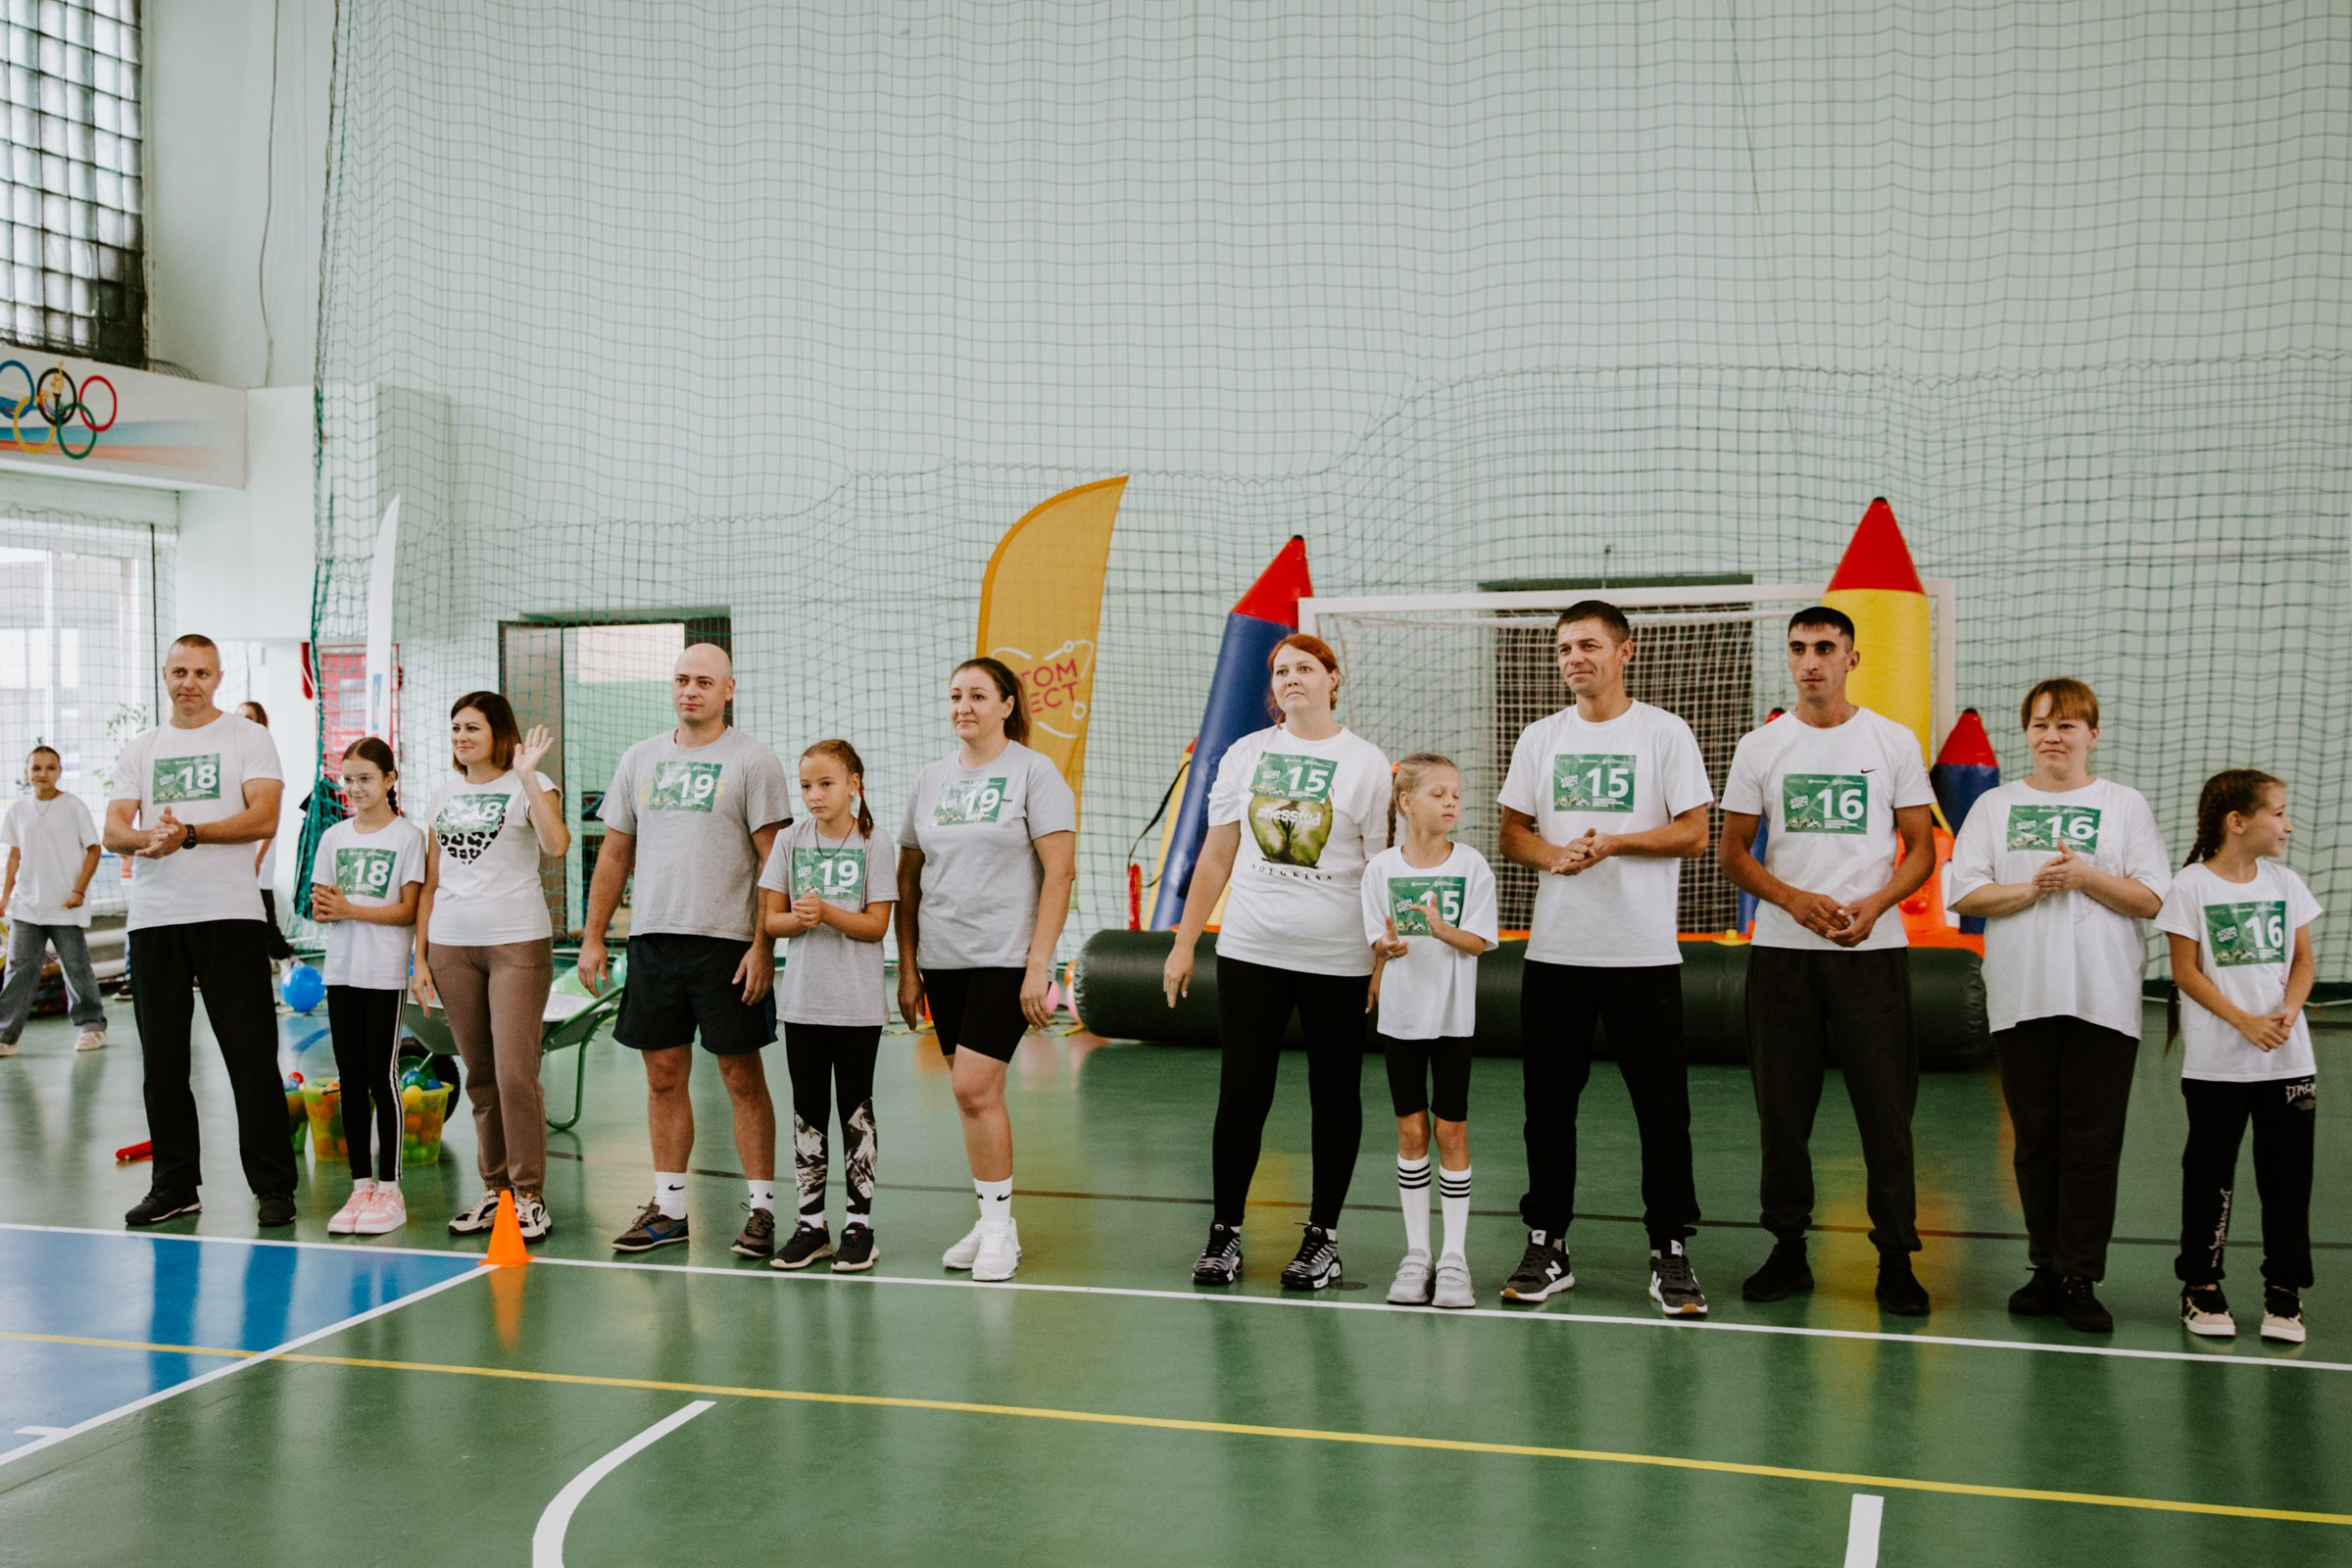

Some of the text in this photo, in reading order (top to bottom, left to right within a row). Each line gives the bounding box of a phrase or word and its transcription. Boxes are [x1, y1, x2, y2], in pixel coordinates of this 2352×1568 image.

[1030, 682, 1077, 713] ЕСТ
[180, 763, 218, 790] 18
[678, 772, 714, 799] 19
[1288, 764, 1329, 793] 15
[1586, 767, 1630, 799] 15
[468, 801, 504, 824] 18
[964, 788, 1000, 814] 19
[1816, 788, 1865, 820] 16
[2045, 815, 2095, 841] 16
[353, 858, 390, 887] 18
[819, 858, 859, 887] 19
[1419, 890, 1460, 922] 15
[2244, 914, 2284, 949] 16
